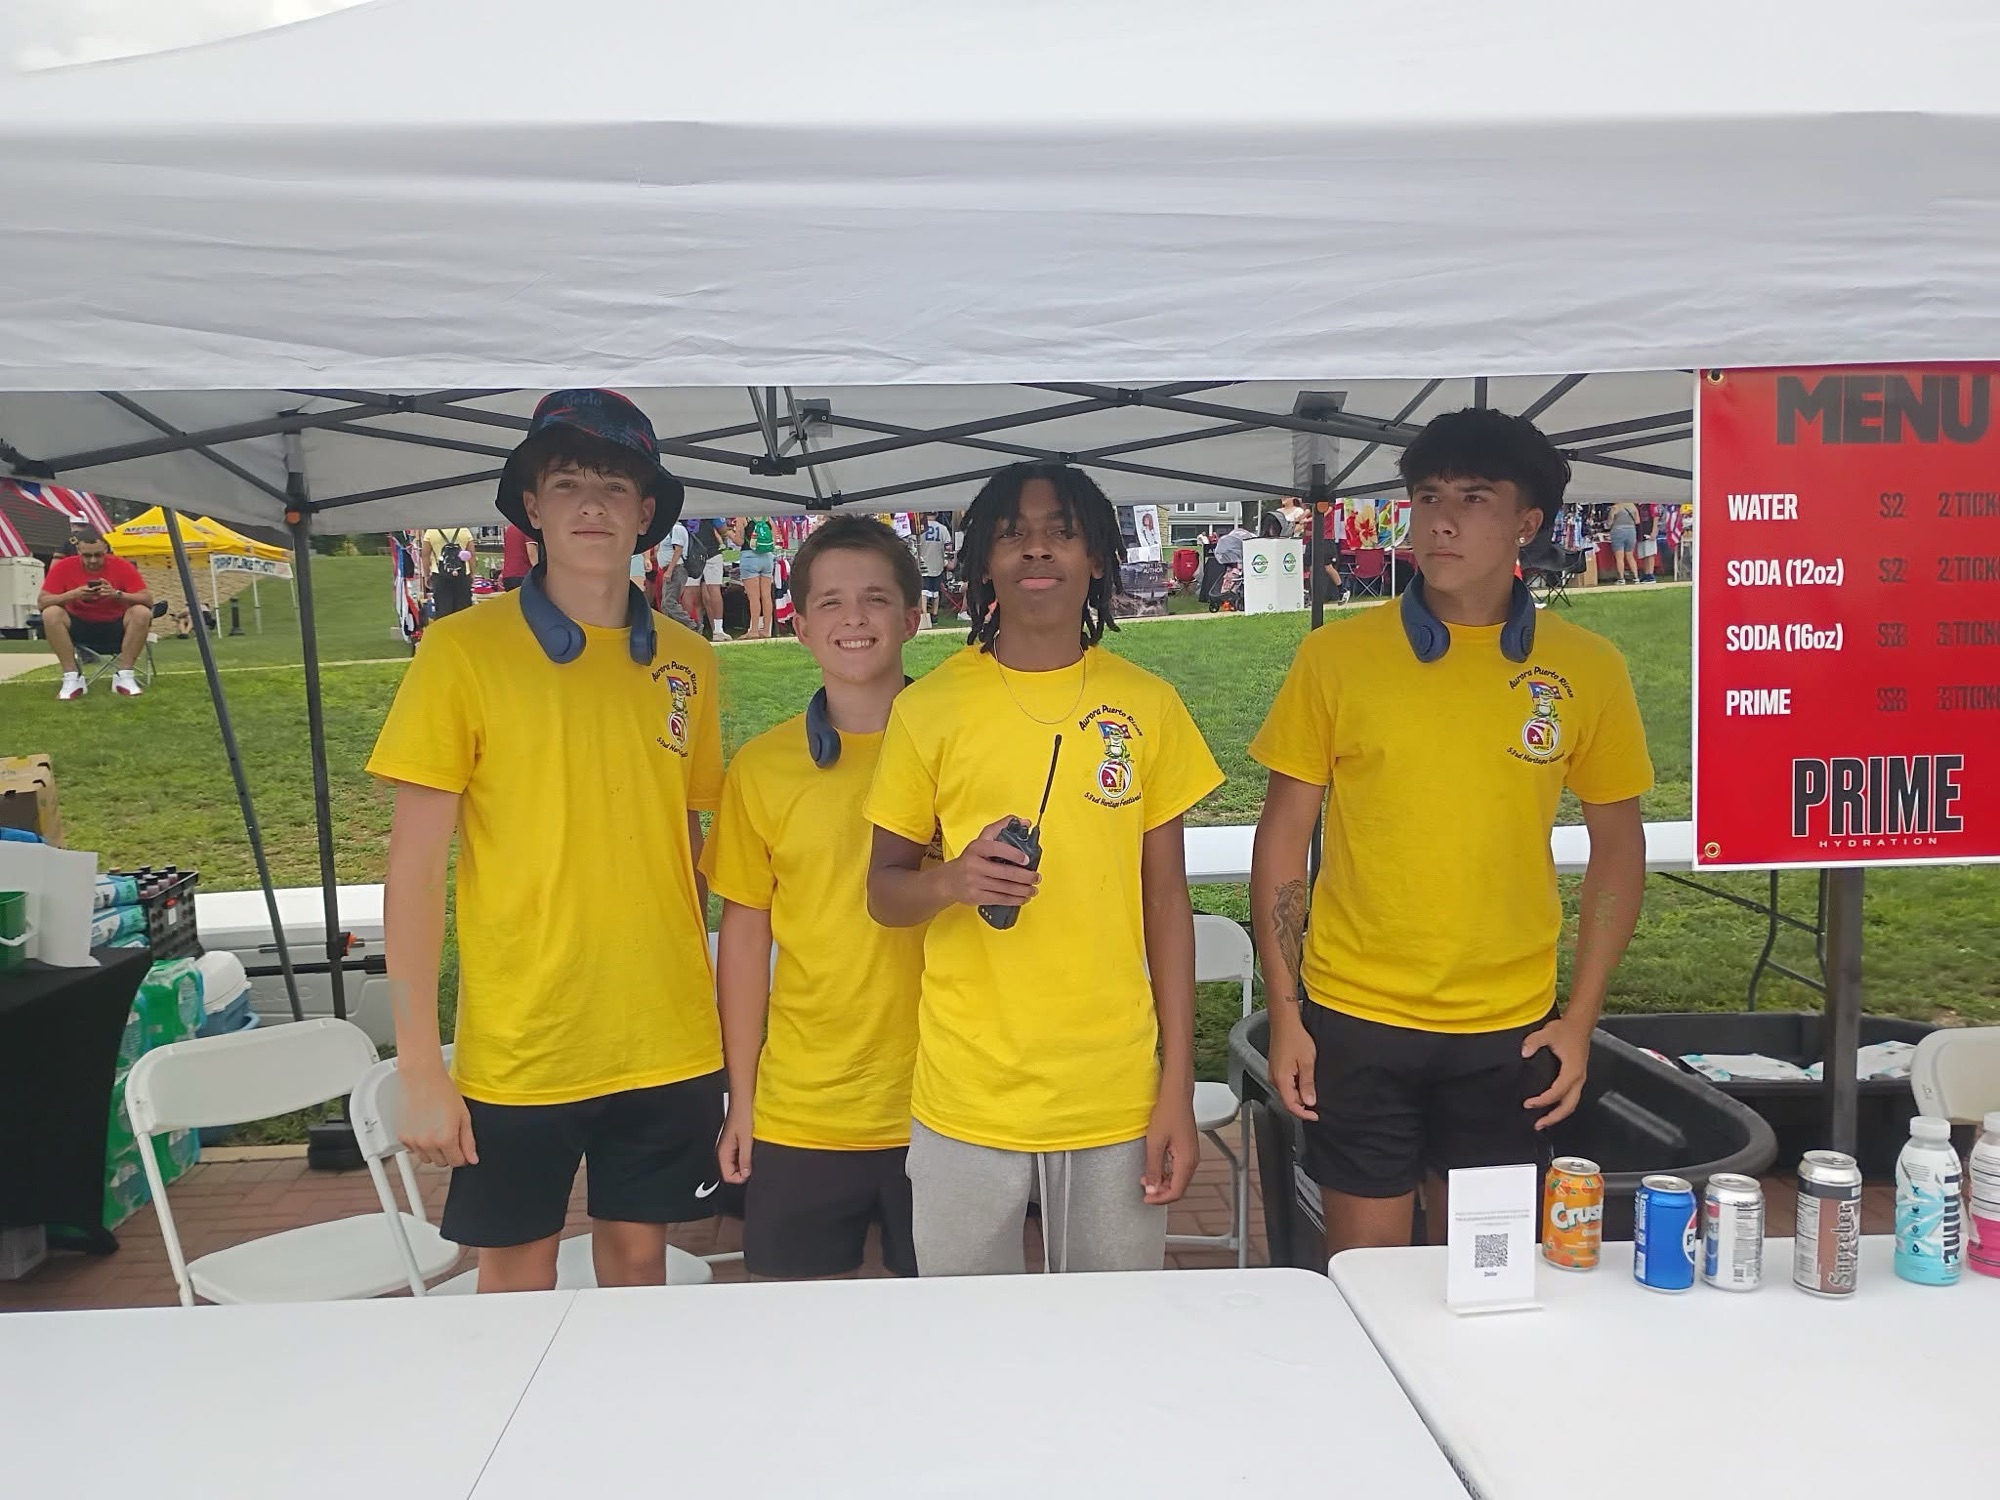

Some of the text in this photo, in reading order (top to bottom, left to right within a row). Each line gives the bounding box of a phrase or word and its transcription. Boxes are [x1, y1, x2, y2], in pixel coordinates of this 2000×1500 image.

[1777, 374, 1991, 446] MENU
[1727, 493, 1798, 521] WATER
[925, 525, 941, 542] 21
[1727, 559, 1781, 586] SODA
[1785, 558, 1844, 587] (12oz)
[1726, 624, 1781, 651] SODA
[1784, 623, 1844, 652] (16oz)
[671, 661, 692, 675] Puerto
[1509, 666, 1574, 698] Aurora Puerto Rican
[1726, 688, 1791, 716] PRIME
[1079, 707, 1101, 731] Aurora
[1101, 704, 1126, 718] Puerto
[1792, 754, 1964, 838] PRIME
[1819, 838, 1938, 848] HYDRATION
